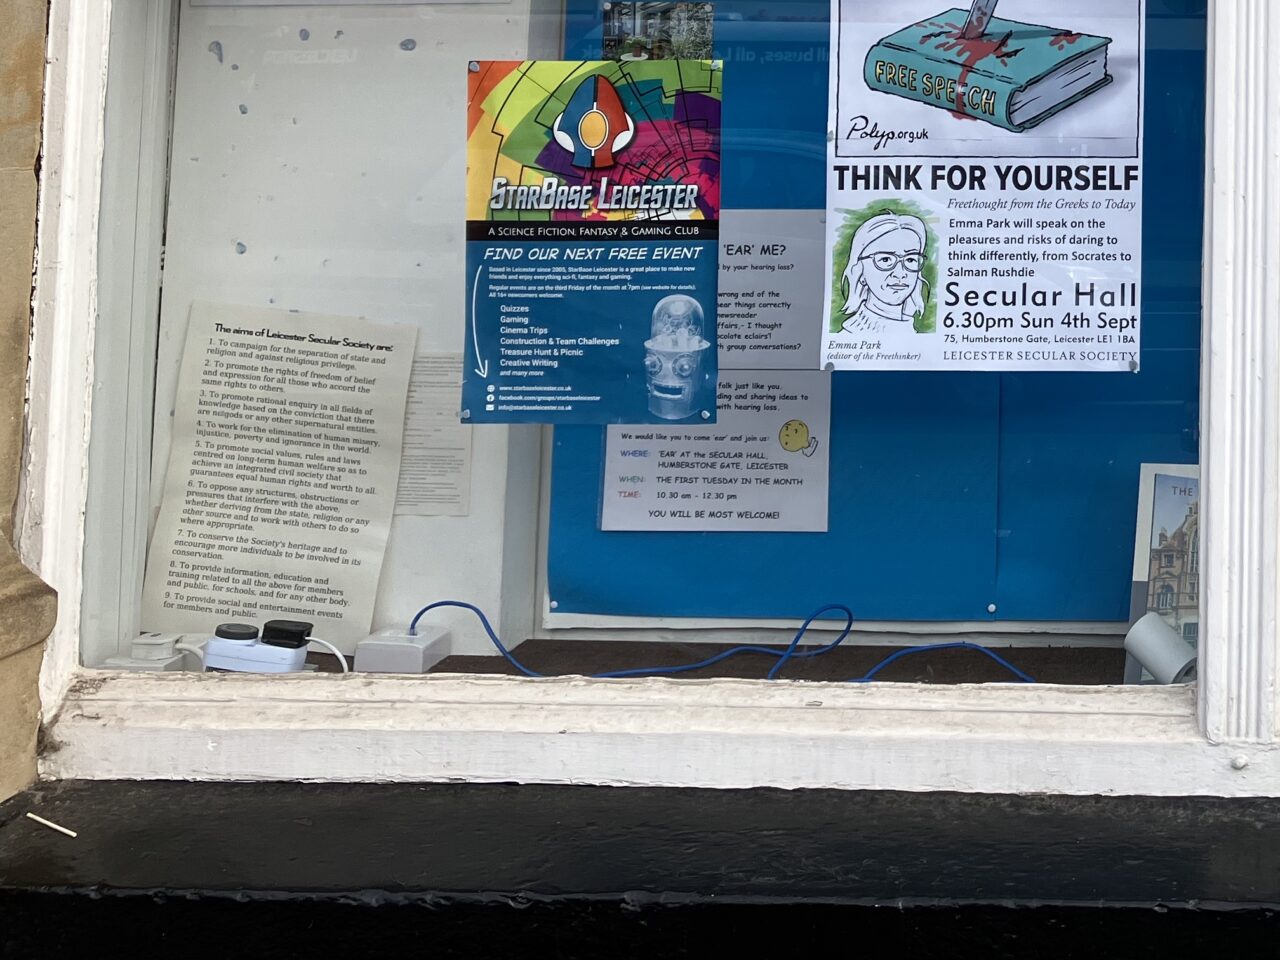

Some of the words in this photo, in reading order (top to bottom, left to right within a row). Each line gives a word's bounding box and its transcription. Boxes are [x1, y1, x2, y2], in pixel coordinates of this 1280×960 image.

[874, 60, 917, 91] FREE
[921, 73, 997, 115] SPEECH
[846, 115, 928, 150] Polyp.org.uk
[833, 165, 922, 190] THINK
[931, 165, 987, 190] FOR
[993, 165, 1139, 190] YOURSELF
[947, 198, 1007, 211] Freethought
[1010, 199, 1032, 211] from
[1036, 199, 1052, 209] the
[1055, 199, 1089, 209] Greeks
[1091, 201, 1101, 209] to
[1104, 199, 1136, 211] Today
[949, 219, 983, 228] Emma
[986, 219, 1010, 228] Park
[1014, 218, 1033, 228] will
[1036, 219, 1067, 230] speak
[1088, 219, 1105, 228] the
[488, 228, 495, 236] A
[498, 227, 534, 236] SCIENCE
[580, 227, 618, 236] FANTASY
[621, 227, 627, 236] &
[631, 227, 671, 236] GAMING
[675, 227, 699, 235] CLUB
[948, 235, 1001, 247] pleasures
[1003, 235, 1024, 245] and
[1027, 235, 1052, 245] risks
[1055, 235, 1066, 245] of
[1069, 235, 1103, 247] daring
[1107, 236, 1118, 245] to
[484, 248, 523, 260] FIND
[528, 248, 559, 259] OUR
[564, 248, 605, 259] NEXT
[609, 247, 648, 259] FREE
[652, 247, 703, 259] EVENT
[760, 244, 786, 256] ME?
[948, 251, 976, 261] think
[980, 251, 1039, 263] differently,
[1042, 251, 1068, 261] from
[1071, 251, 1117, 261] Socrates
[1120, 253, 1131, 261] to
[947, 267, 988, 277] Salman
[991, 267, 1035, 277] Rushdie
[944, 282, 1062, 307] Secular
[1075, 282, 1136, 307] Hall
[500, 305, 529, 313] Quizzes
[500, 316, 528, 325] Gaming
[943, 315, 1014, 331] 6.30pm
[1021, 313, 1054, 328] Sun
[1061, 314, 1090, 328] 4th
[1097, 314, 1137, 332] Sept
[530, 327, 548, 335] Trips
[215, 323, 231, 334] The
[232, 327, 253, 336] aims
[254, 328, 265, 337] of
[266, 329, 306, 343] Leicester
[308, 334, 341, 345] Secular
[343, 337, 375, 352] Society
[578, 338, 619, 346] Challenges
[944, 334, 958, 344] 75,
[962, 334, 1023, 343] Humberstone
[1026, 334, 1050, 345] Gate,
[1054, 335, 1094, 343] Leicester
[1097, 335, 1113, 343] LE1
[1118, 335, 1135, 343] 1BA
[828, 341, 857, 349] Emma
[860, 341, 881, 349] Park
[534, 348, 551, 356] Hunt
[560, 348, 583, 356] Picnic
[944, 351, 1013, 360] LEICESTER
[1017, 351, 1076, 360] SECULAR
[1080, 352, 1137, 361] SOCIETY
[500, 359, 530, 367] Creative
[532, 359, 558, 368] Writing
[658, 462, 717, 470] HUMBERSTONE
[1172, 486, 1193, 496] THE
[737, 511, 780, 519] WELCOME!
